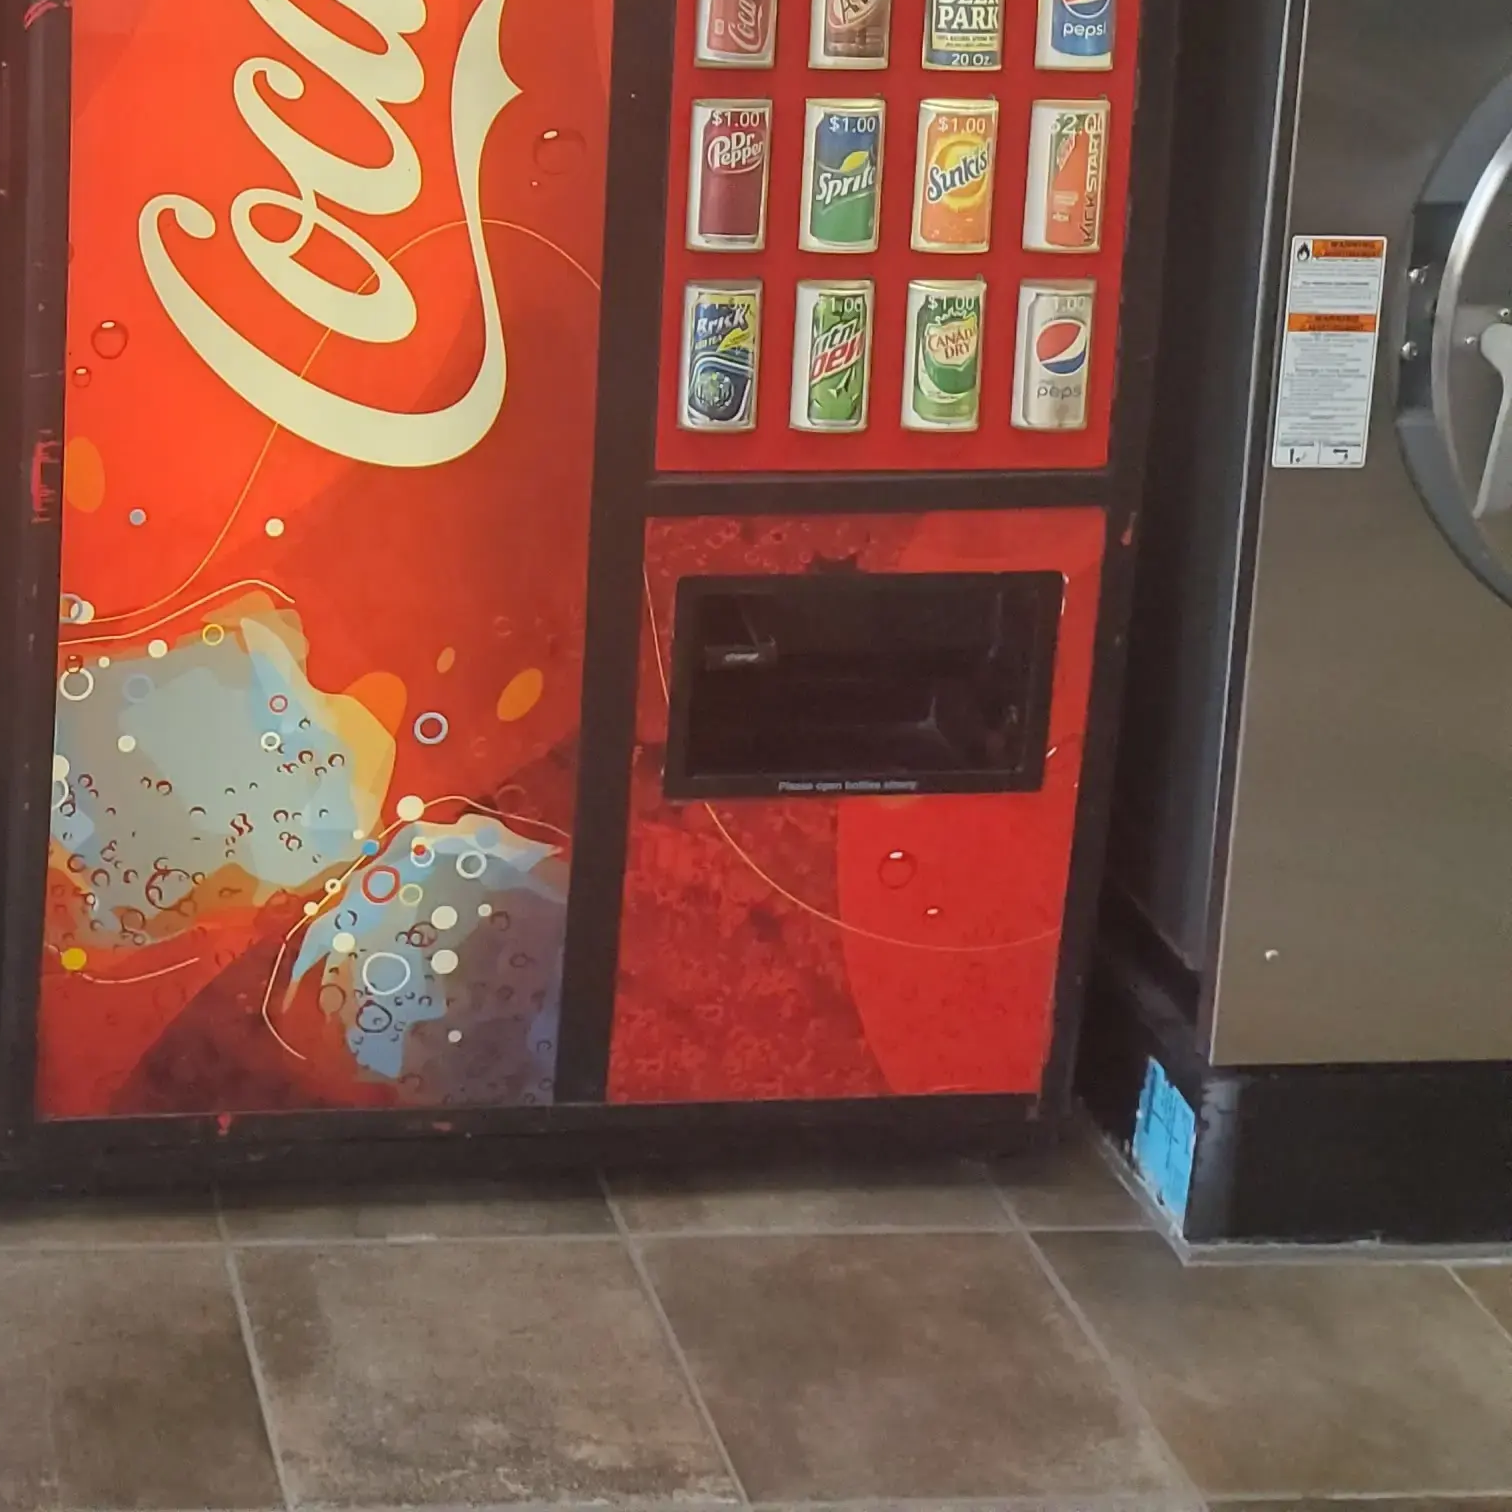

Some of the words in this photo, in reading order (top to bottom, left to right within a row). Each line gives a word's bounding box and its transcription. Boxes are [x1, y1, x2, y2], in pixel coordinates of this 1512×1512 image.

[938, 6, 998, 29] PARK
[951, 54, 969, 65] 20
[711, 111, 760, 127] $1.00
[829, 116, 876, 133] $1.00
[938, 118, 986, 134] $1.00
[731, 132, 755, 149] Dr
[710, 137, 764, 168] Pepper
[928, 294, 975, 311] $1.00
[944, 340, 971, 360] DRY
